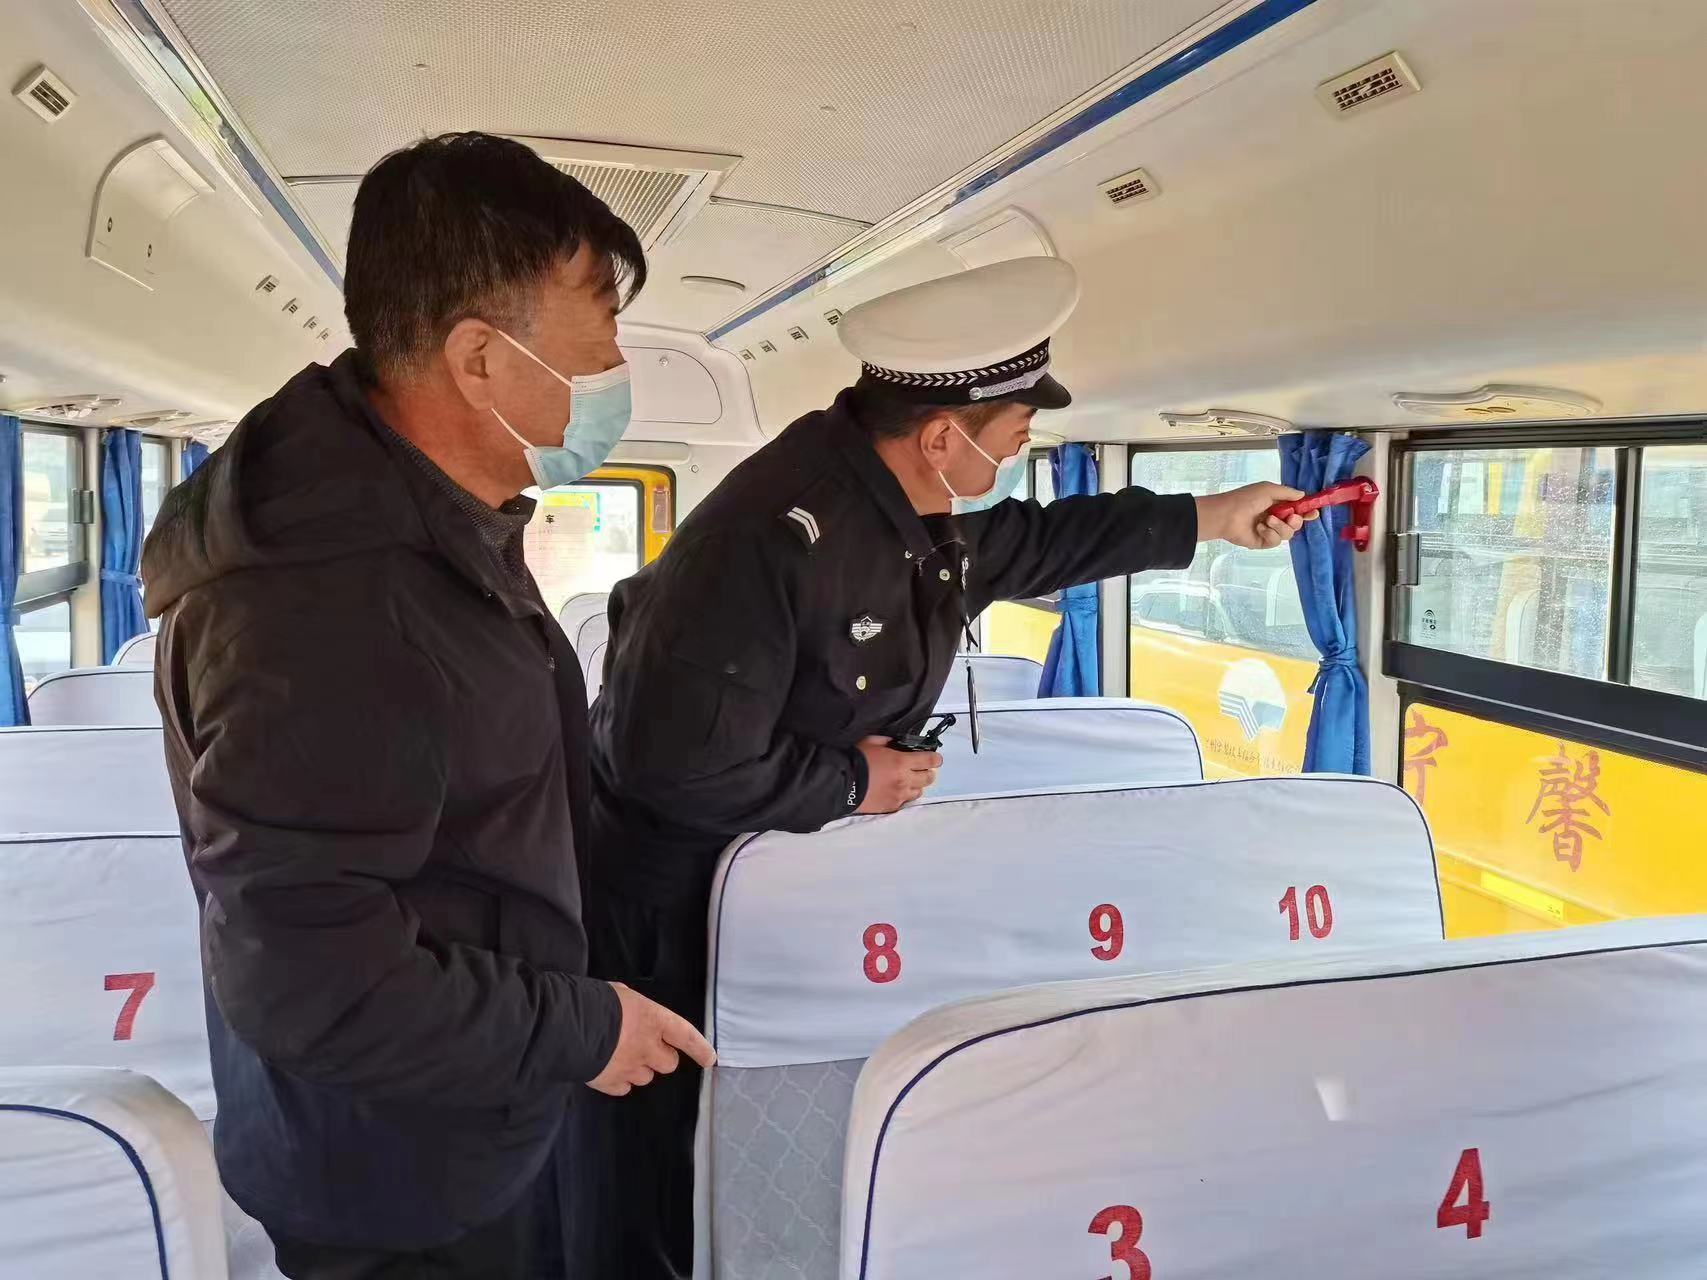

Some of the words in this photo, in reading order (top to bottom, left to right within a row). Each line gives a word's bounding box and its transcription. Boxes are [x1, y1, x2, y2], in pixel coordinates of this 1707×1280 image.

[847, 781, 857, 806] POL
[1089, 904, 1123, 961] 9
[1279, 885, 1333, 940] 10
[863, 923, 902, 984] 8
[104, 972, 155, 1040] 7
[1437, 1148, 1490, 1239] 4
[1088, 1205, 1150, 1280] 3
